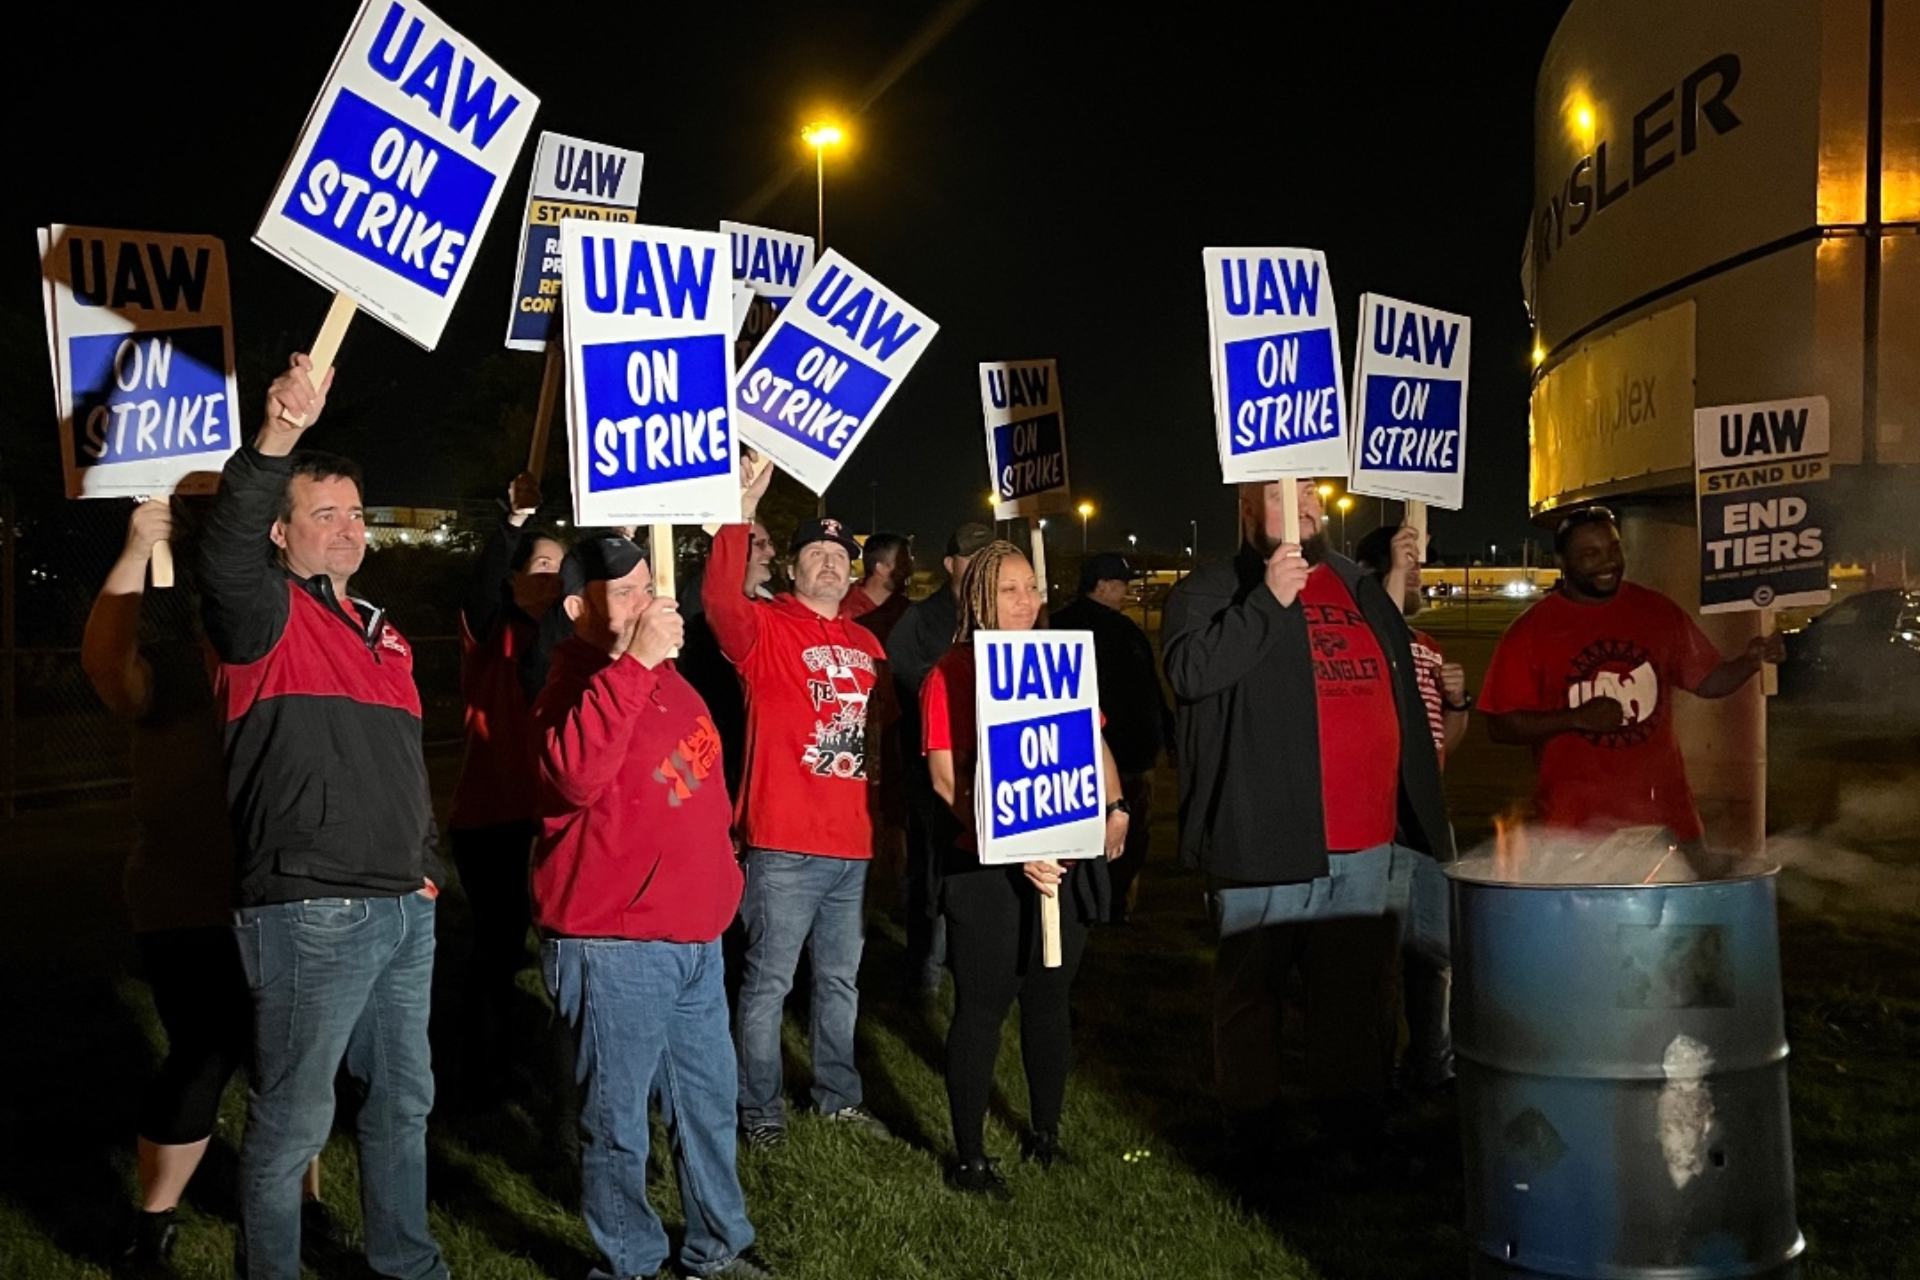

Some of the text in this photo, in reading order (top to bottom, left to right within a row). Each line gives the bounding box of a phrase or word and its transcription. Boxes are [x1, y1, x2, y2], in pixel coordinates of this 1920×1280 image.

[368, 1, 520, 151] UAW
[371, 127, 438, 198] ON
[554, 144, 627, 199] UAW
[300, 159, 465, 280] STRIKE
[537, 206, 629, 223] STAND UP
[69, 239, 209, 312] UAW
[581, 236, 716, 321] UAW
[730, 232, 804, 288] UAW
[1221, 258, 1320, 317] UAW
[806, 264, 921, 363] UAW
[1373, 304, 1460, 369] UAW
[115, 337, 172, 392] ON
[626, 348, 678, 406] ON
[796, 345, 849, 393] ON
[988, 366, 1050, 409] UAW
[1257, 337, 1299, 388] ON
[83, 392, 225, 458] STRIKE
[741, 367, 859, 450] STRIKE
[1235, 387, 1336, 447] STRIKE
[1391, 380, 1430, 420] ON
[593, 406, 729, 477] STRIKE
[1013, 421, 1038, 456] ON
[1365, 426, 1458, 468] STRIKE
[1720, 408, 1808, 457] UAW
[1002, 453, 1061, 497] STRIKE
[1708, 462, 1822, 491] STAND UP
[1724, 497, 1808, 535] END
[1706, 527, 1823, 570] TIERS
[987, 643, 1084, 701] UAW
[1020, 723, 1060, 770] ON
[996, 764, 1096, 827] STRIKE
